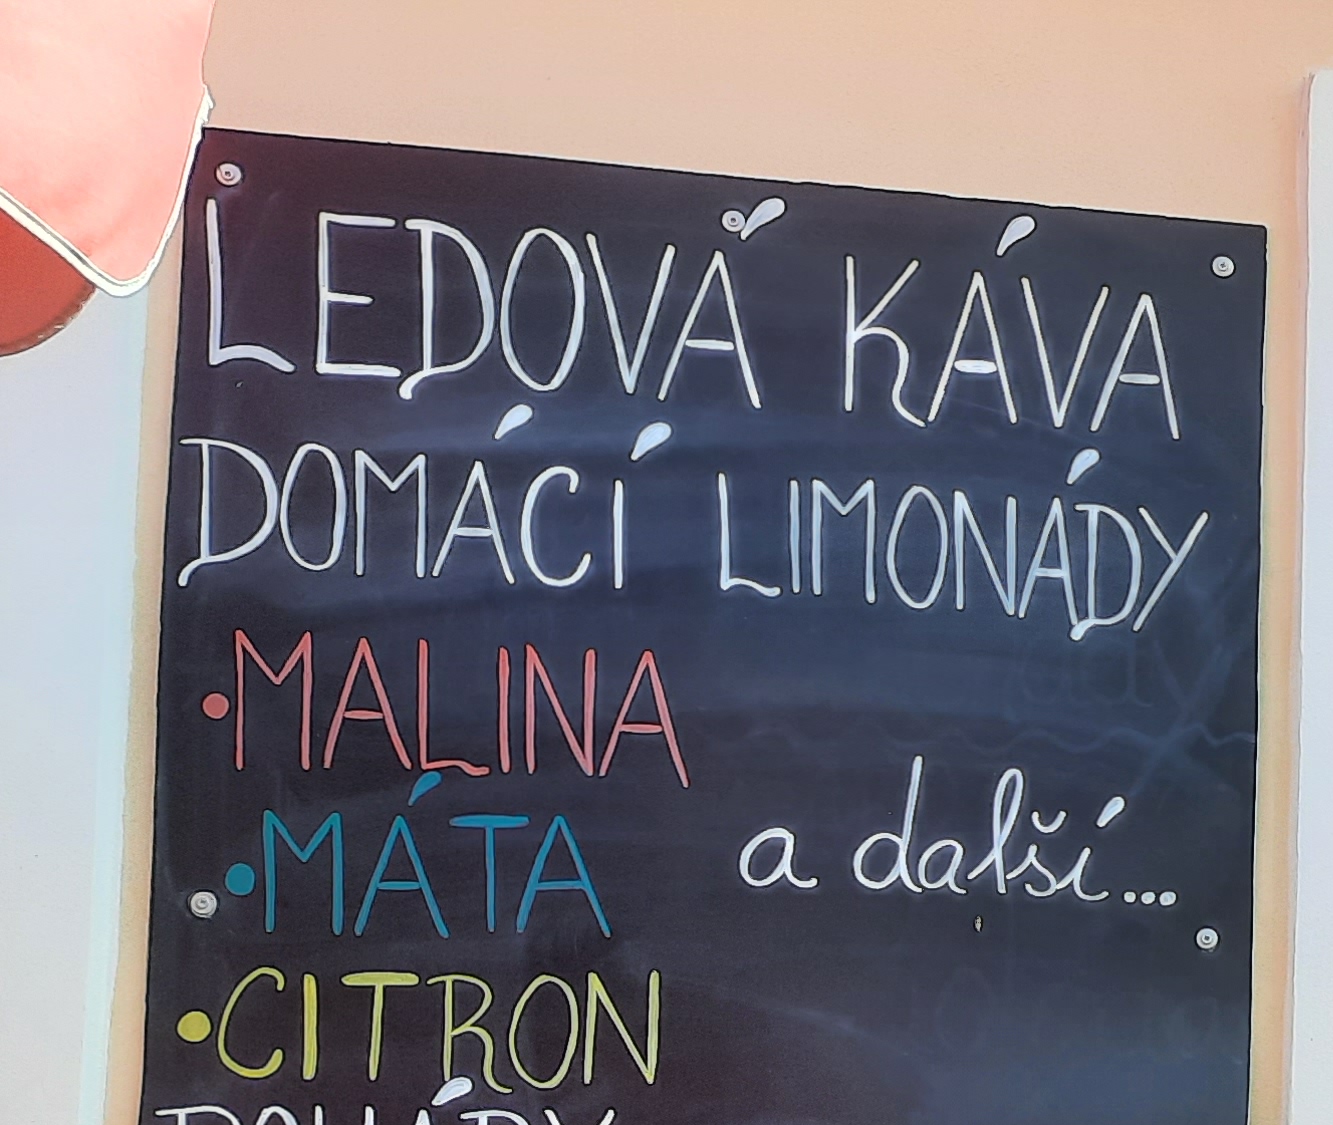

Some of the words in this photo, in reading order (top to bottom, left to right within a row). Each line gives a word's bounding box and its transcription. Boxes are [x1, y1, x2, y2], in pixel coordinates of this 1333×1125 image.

[204, 195, 787, 410] LEDOVÁ
[843, 214, 1181, 441] KÁVA
[177, 403, 673, 588] DOMÁCÍ
[716, 448, 1210, 643] LIMONÁDY
[232, 629, 690, 789] MALINA
[263, 770, 612, 937] MÁTA
[738, 822, 819, 891] a
[215, 965, 661, 1094] CITRON
